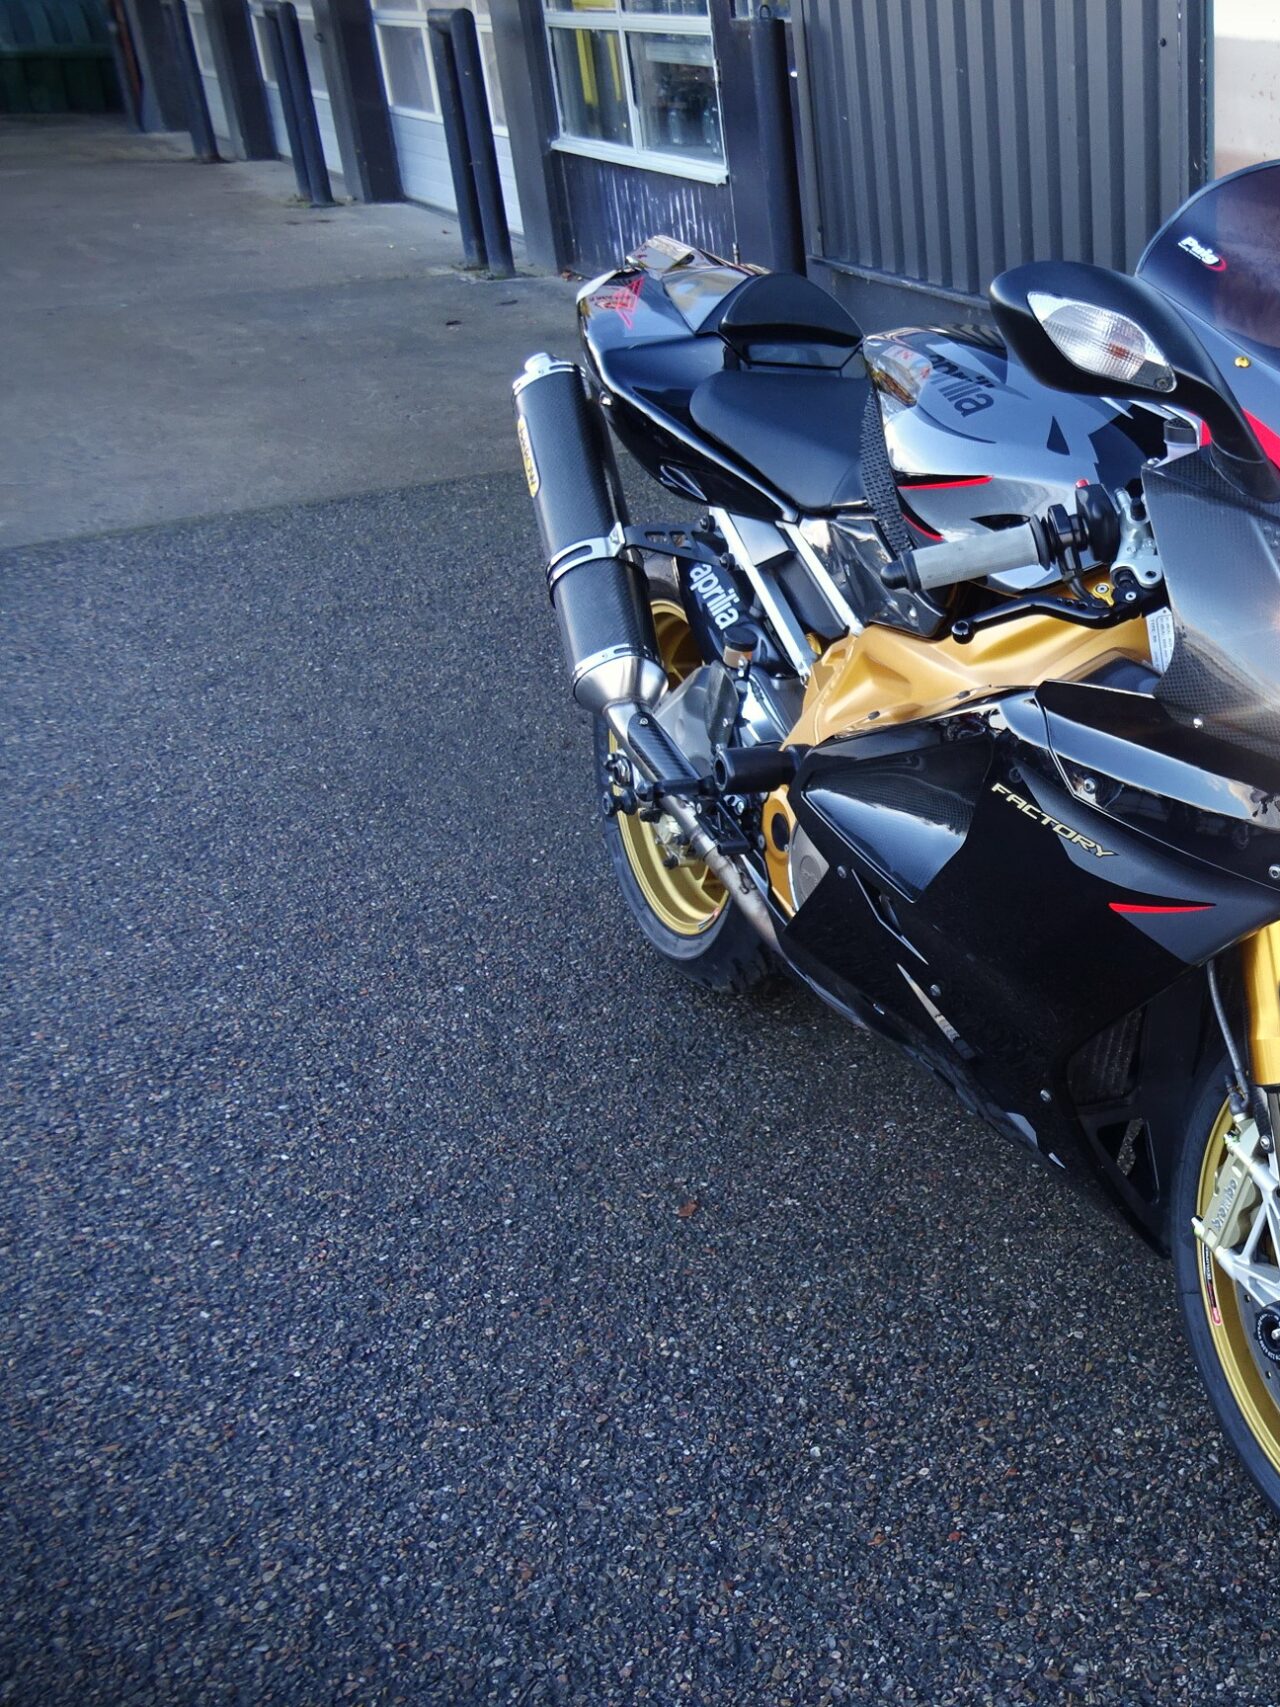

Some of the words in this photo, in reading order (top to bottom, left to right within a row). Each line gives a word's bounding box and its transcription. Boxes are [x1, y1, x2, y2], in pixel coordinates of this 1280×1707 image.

[1180, 236, 1220, 265] Puig
[689, 563, 740, 630] aprilia
[991, 782, 1119, 858] FACTORY
[1212, 1179, 1237, 1229] brembo
